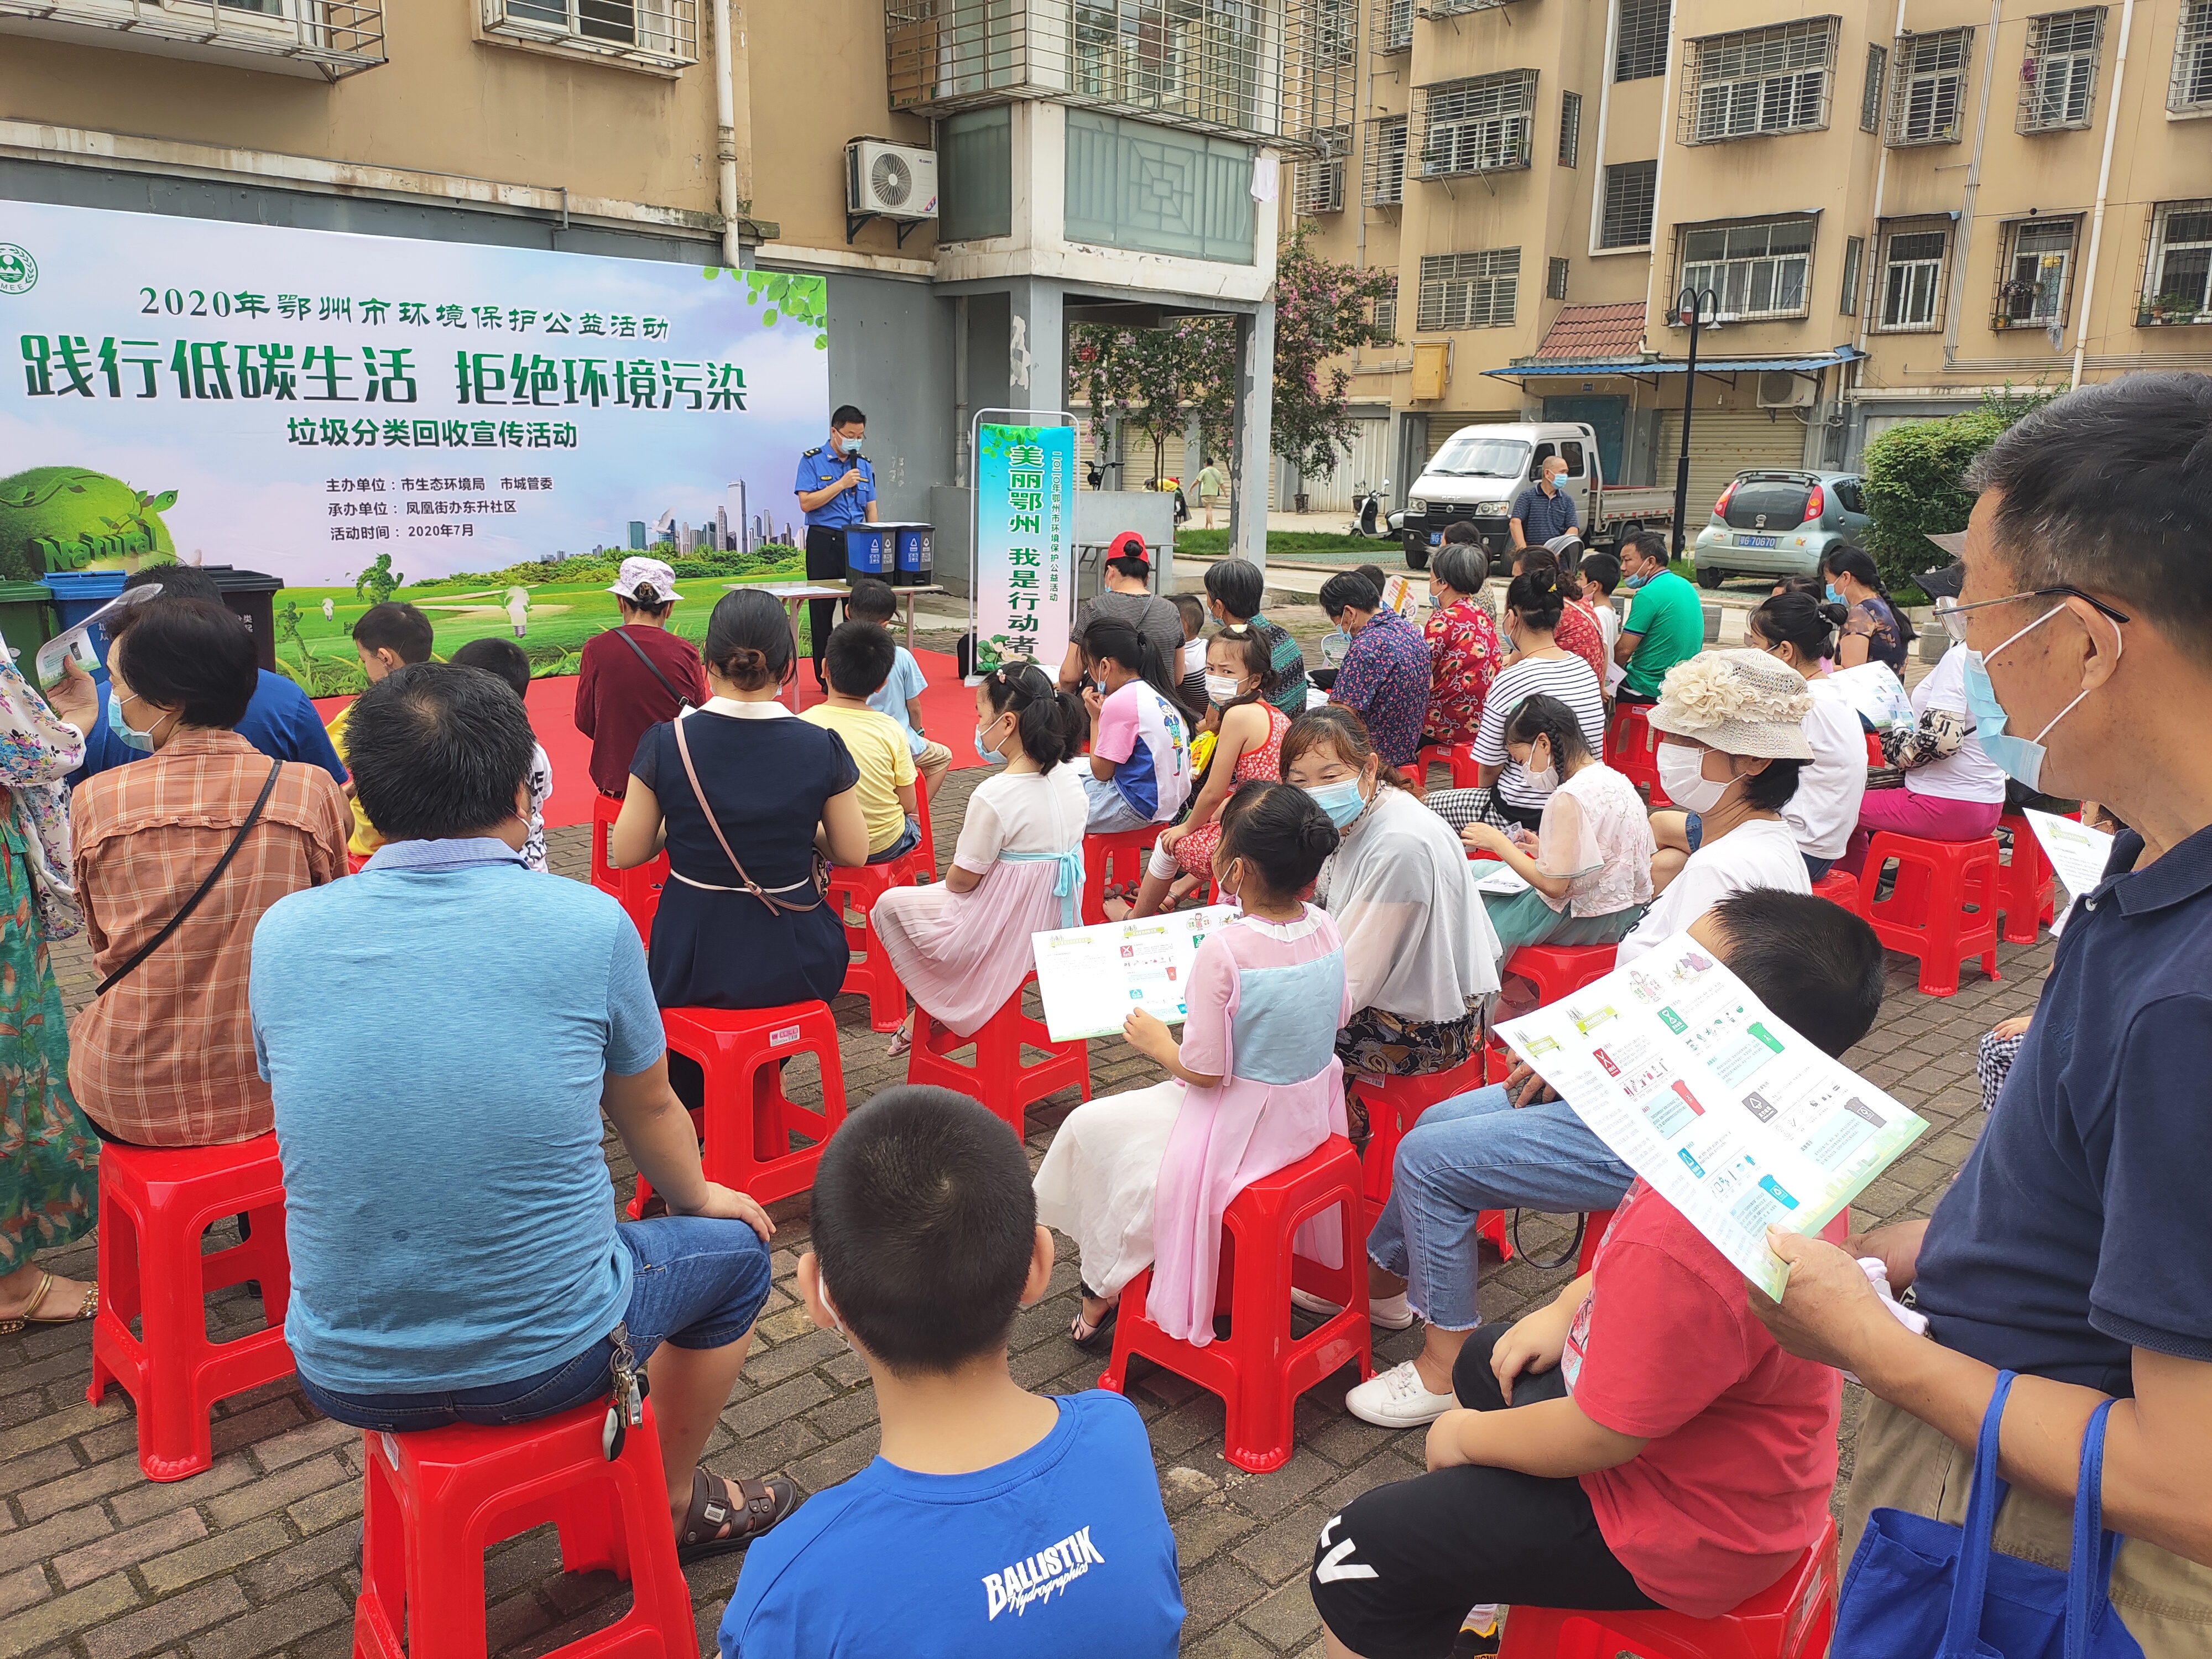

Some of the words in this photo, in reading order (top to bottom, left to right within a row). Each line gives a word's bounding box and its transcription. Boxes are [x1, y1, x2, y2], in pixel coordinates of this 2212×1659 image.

[1, 283, 24, 291] MEE
[139, 286, 669, 341] 2020年鄂州市环境保护公益活动
[20, 334, 418, 403] 践行低碳生活
[454, 350, 748, 411] 拒绝环境污染
[287, 416, 577, 448] 垃圾分类回收宣传活动
[500, 477, 554, 491] 市城管委
[30, 523, 158, 573] Natural
[982, 1525, 1105, 1621] BALLISTIK
[1008, 1561, 1089, 1617] Hydrographics
